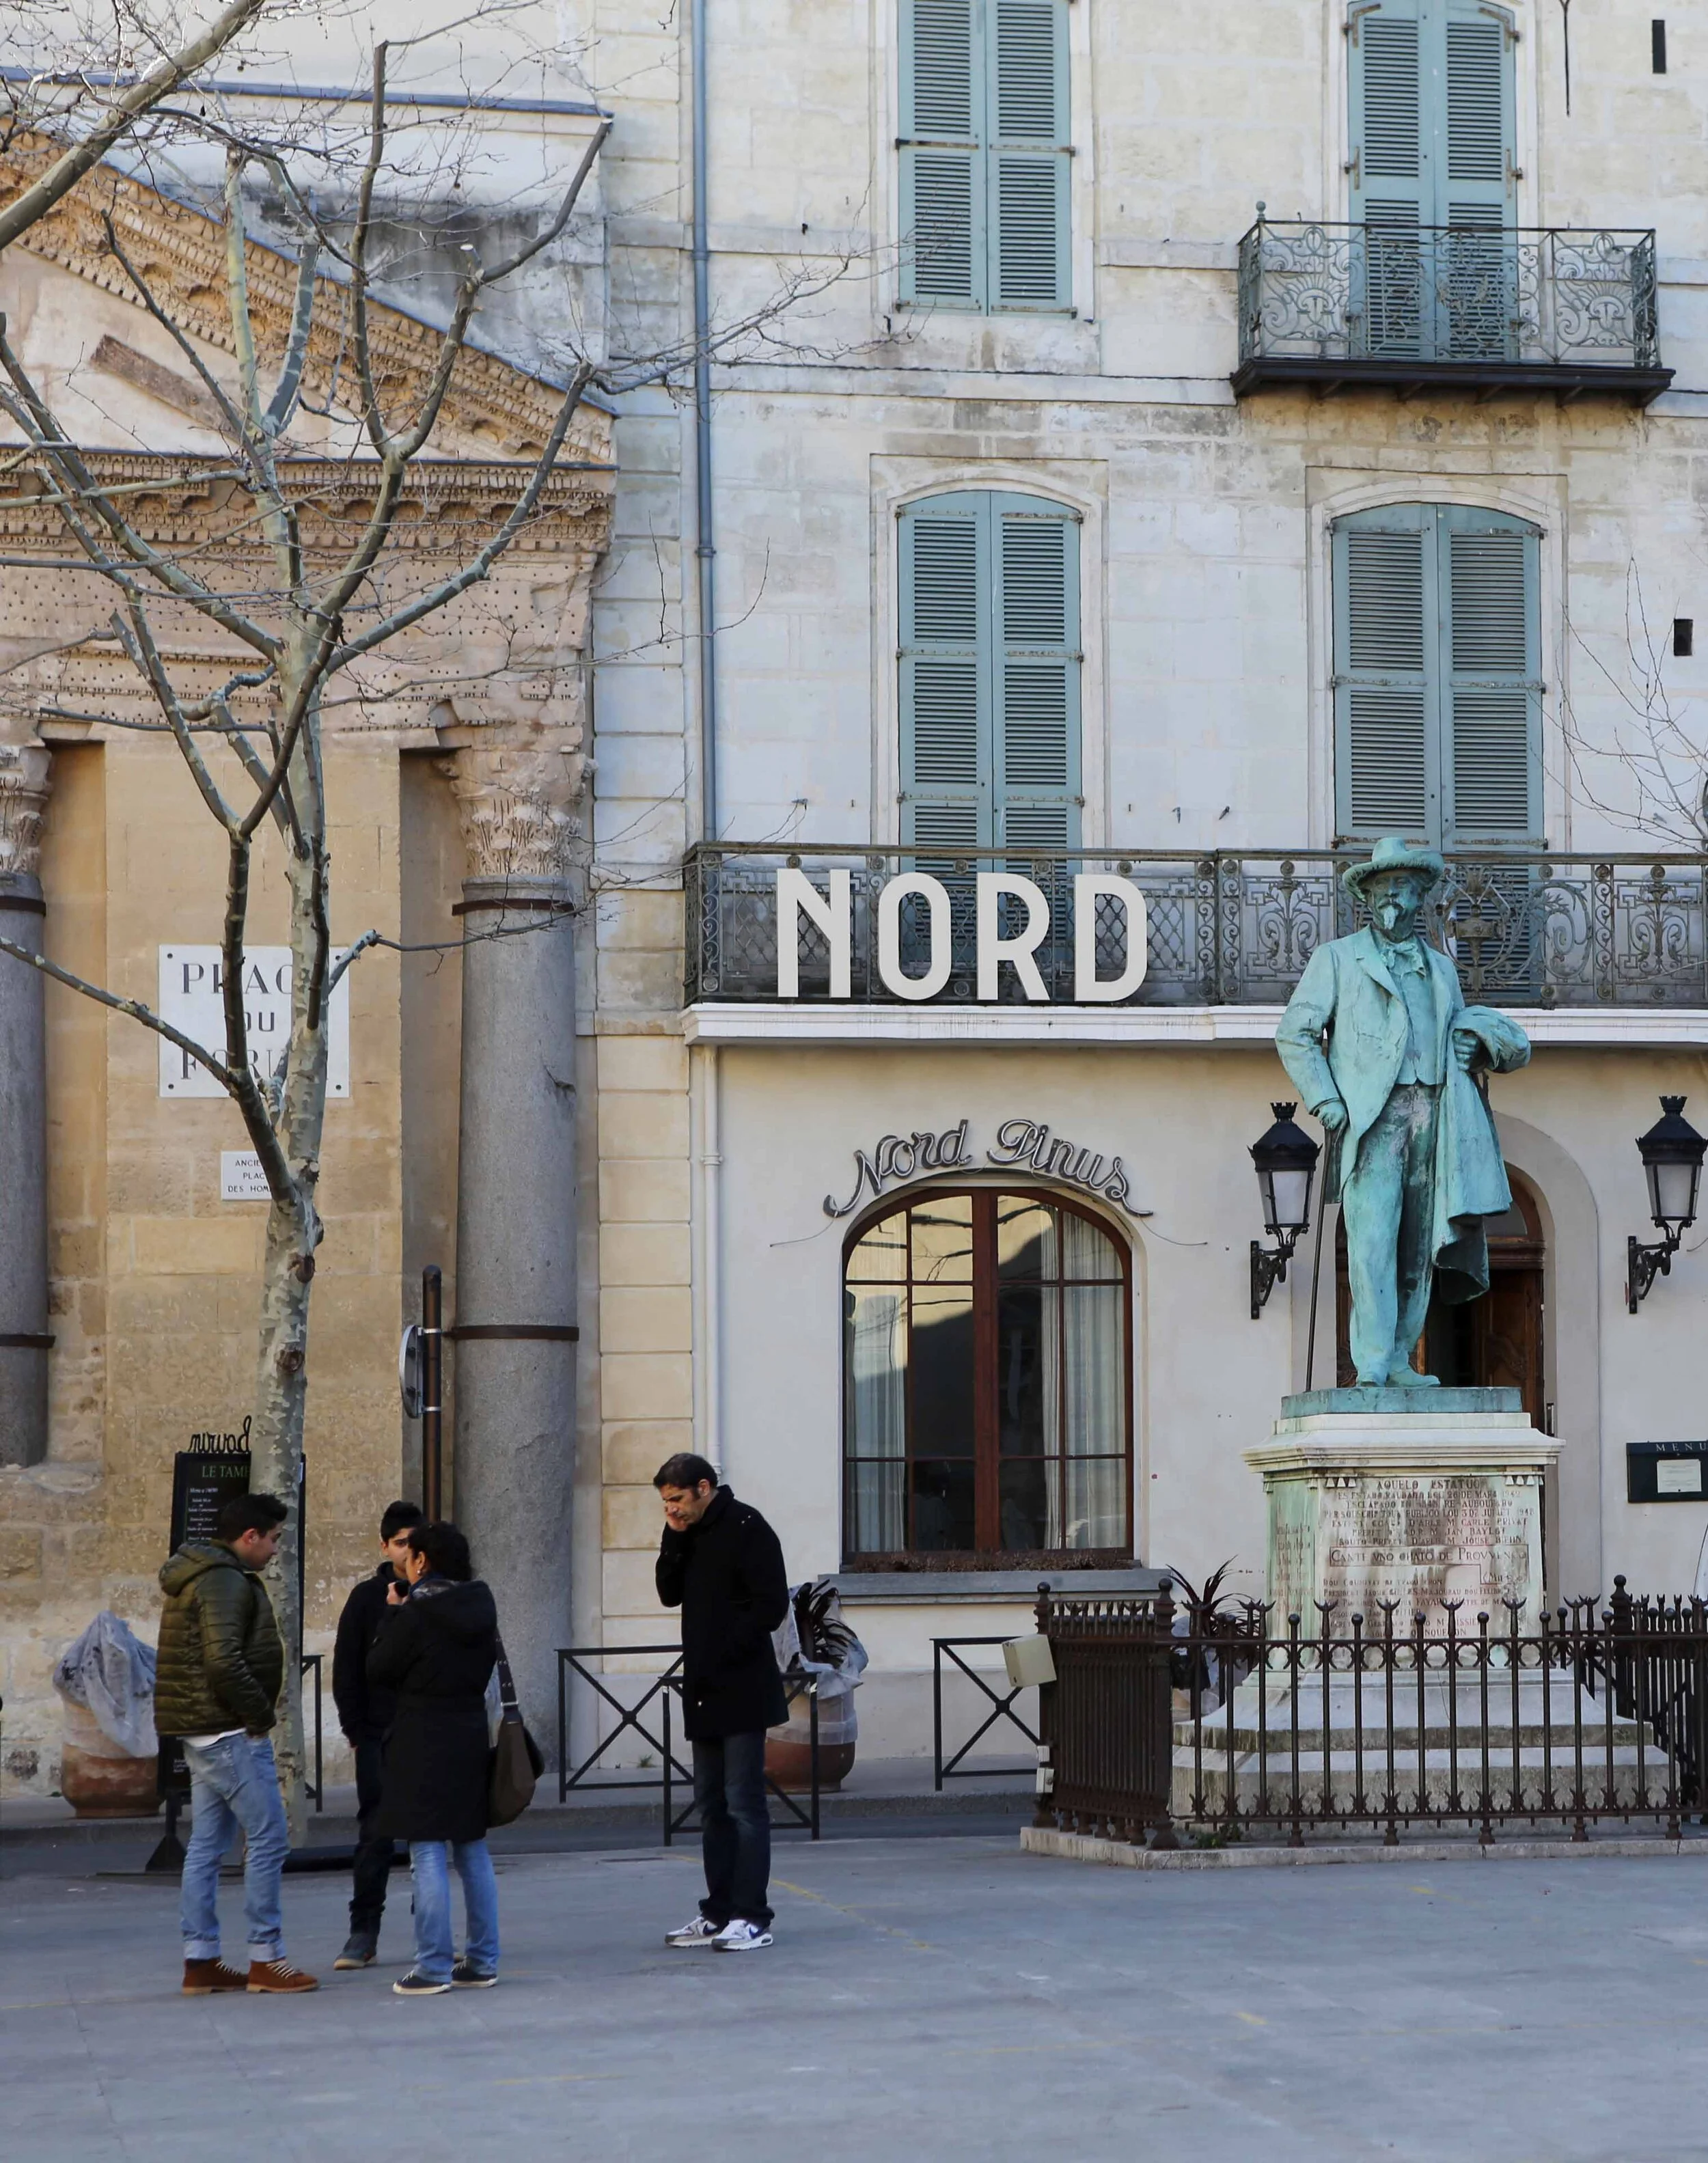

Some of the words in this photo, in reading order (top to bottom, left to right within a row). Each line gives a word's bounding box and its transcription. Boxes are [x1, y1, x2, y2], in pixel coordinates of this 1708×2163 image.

[777, 868, 1148, 1002] NORD
[181, 963, 292, 995] PLAC
[822, 1119, 973, 1218] Nord
[986, 1118, 1154, 1217] Pinus
[1655, 1442, 1707, 1452] MENU
[202, 1465, 217, 1478] LE
[219, 1465, 251, 1478] TAM
